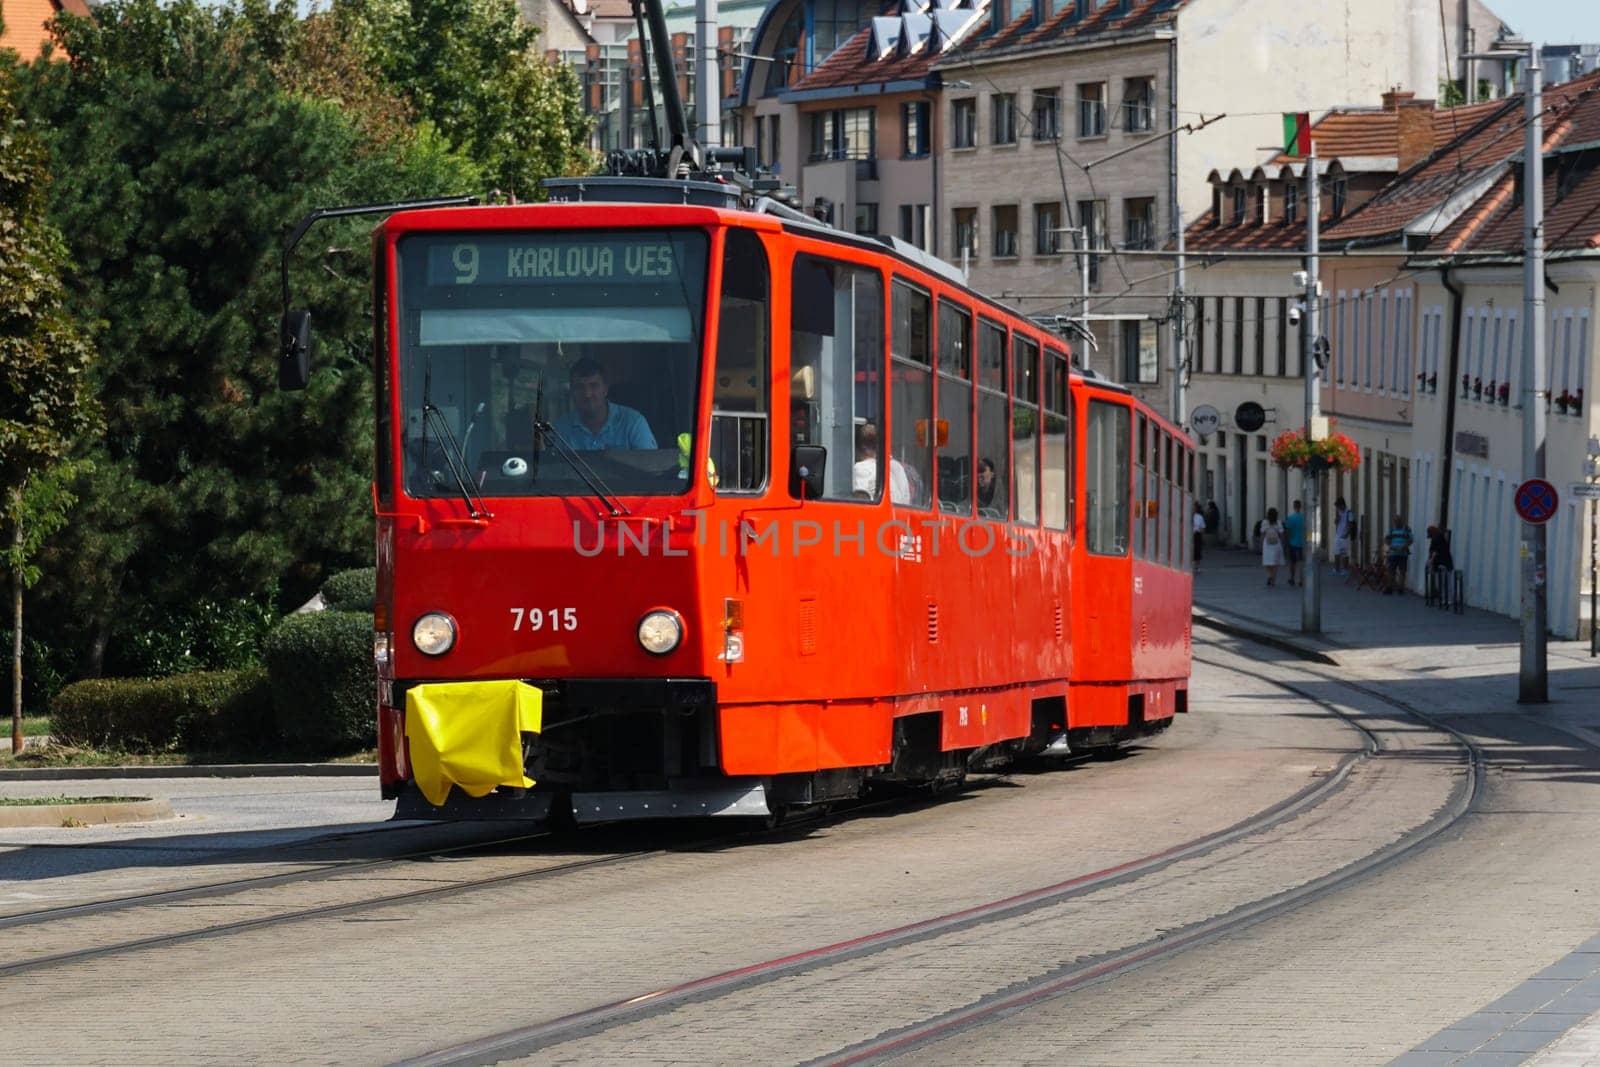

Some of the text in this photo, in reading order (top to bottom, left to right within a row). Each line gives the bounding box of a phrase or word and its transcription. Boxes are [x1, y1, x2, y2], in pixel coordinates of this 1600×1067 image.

[452, 244, 673, 284] 9 KARLOVA VES
[510, 607, 578, 631] 7915
